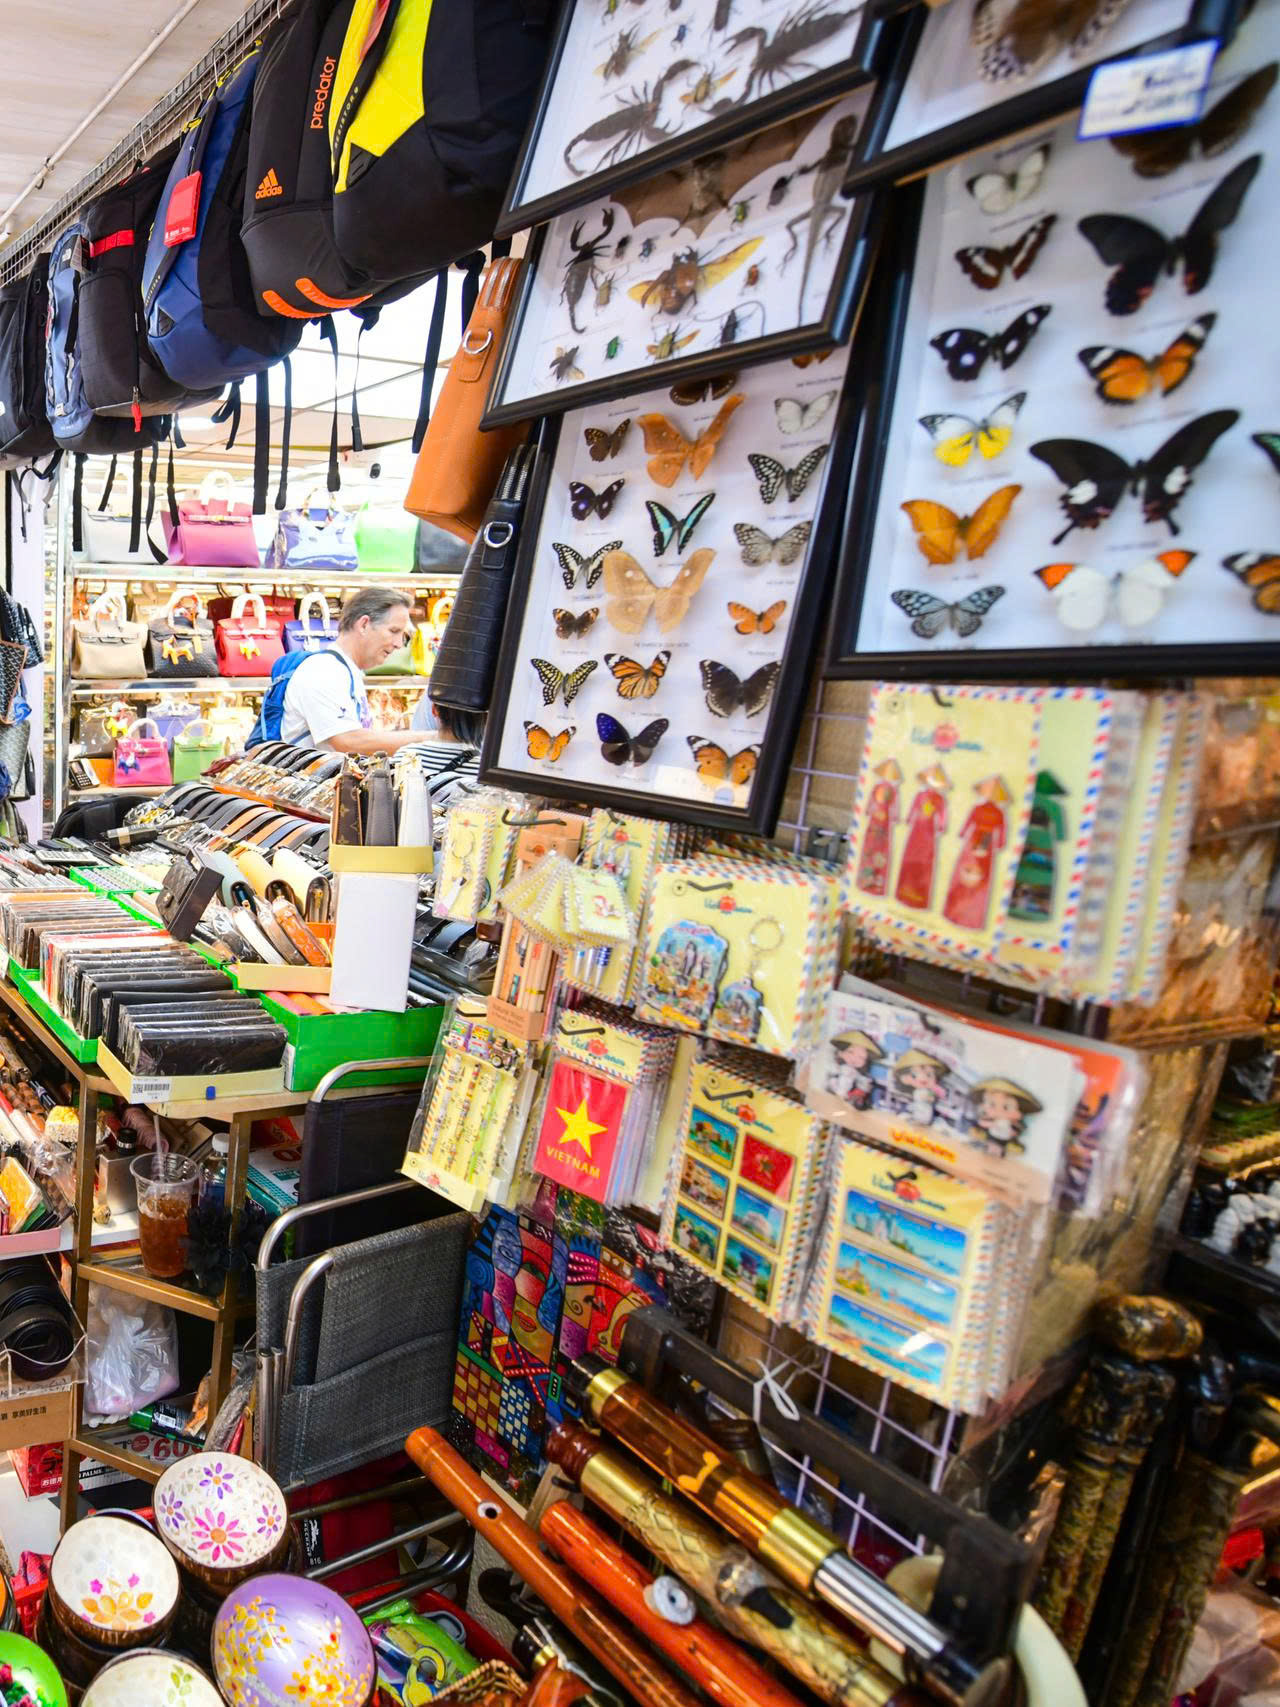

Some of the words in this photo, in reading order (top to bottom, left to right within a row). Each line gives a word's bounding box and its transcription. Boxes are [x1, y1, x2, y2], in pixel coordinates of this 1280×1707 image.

[310, 56, 337, 129] predator
[255, 185, 283, 199] adidas
[546, 1146, 601, 1179] VIETNAM
